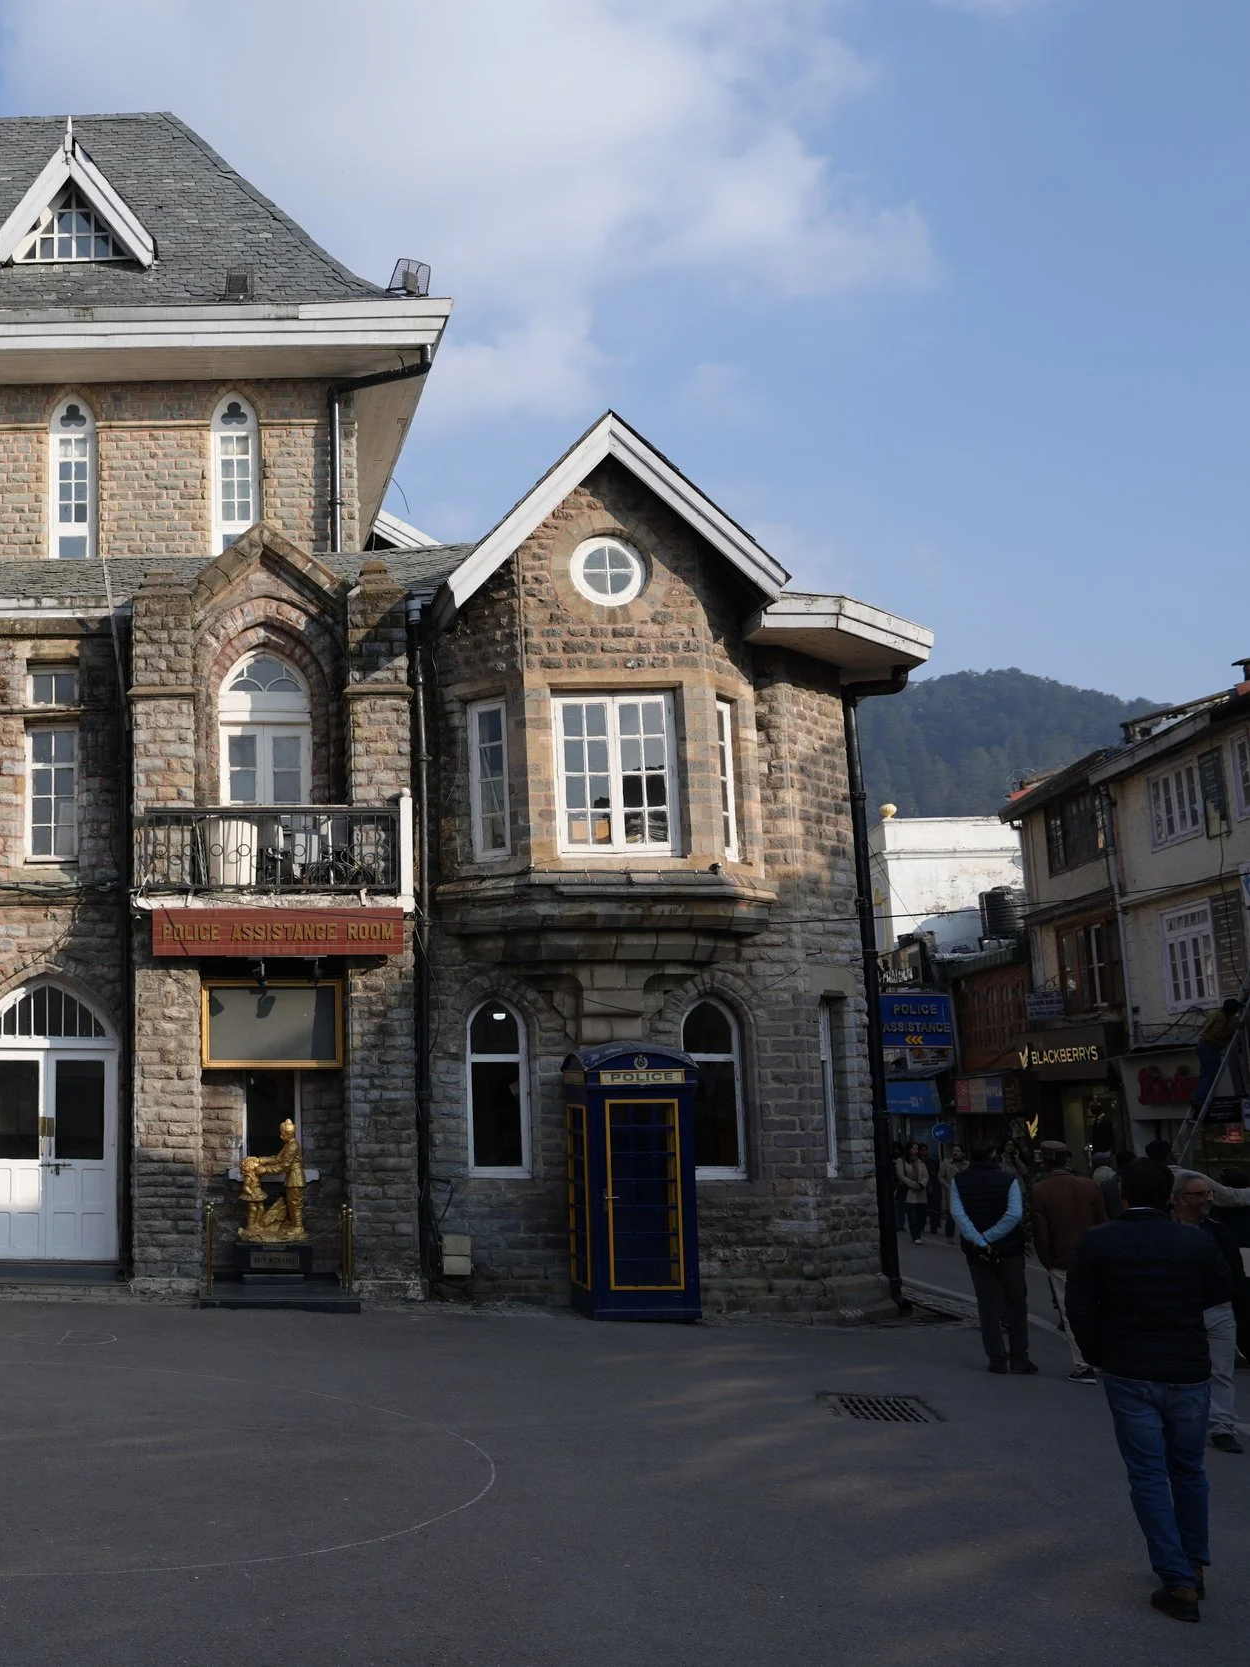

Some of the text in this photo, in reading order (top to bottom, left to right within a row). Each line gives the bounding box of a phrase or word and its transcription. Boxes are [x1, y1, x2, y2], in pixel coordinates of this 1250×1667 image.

[161, 922, 395, 942] POLICE ASSISTANCE ROOM
[893, 1003, 938, 1016] POLICE
[882, 1022, 951, 1033] ASSISTANCE
[1030, 1045, 1099, 1065] BLACKBERRYS
[610, 1072, 673, 1081] POLICE
